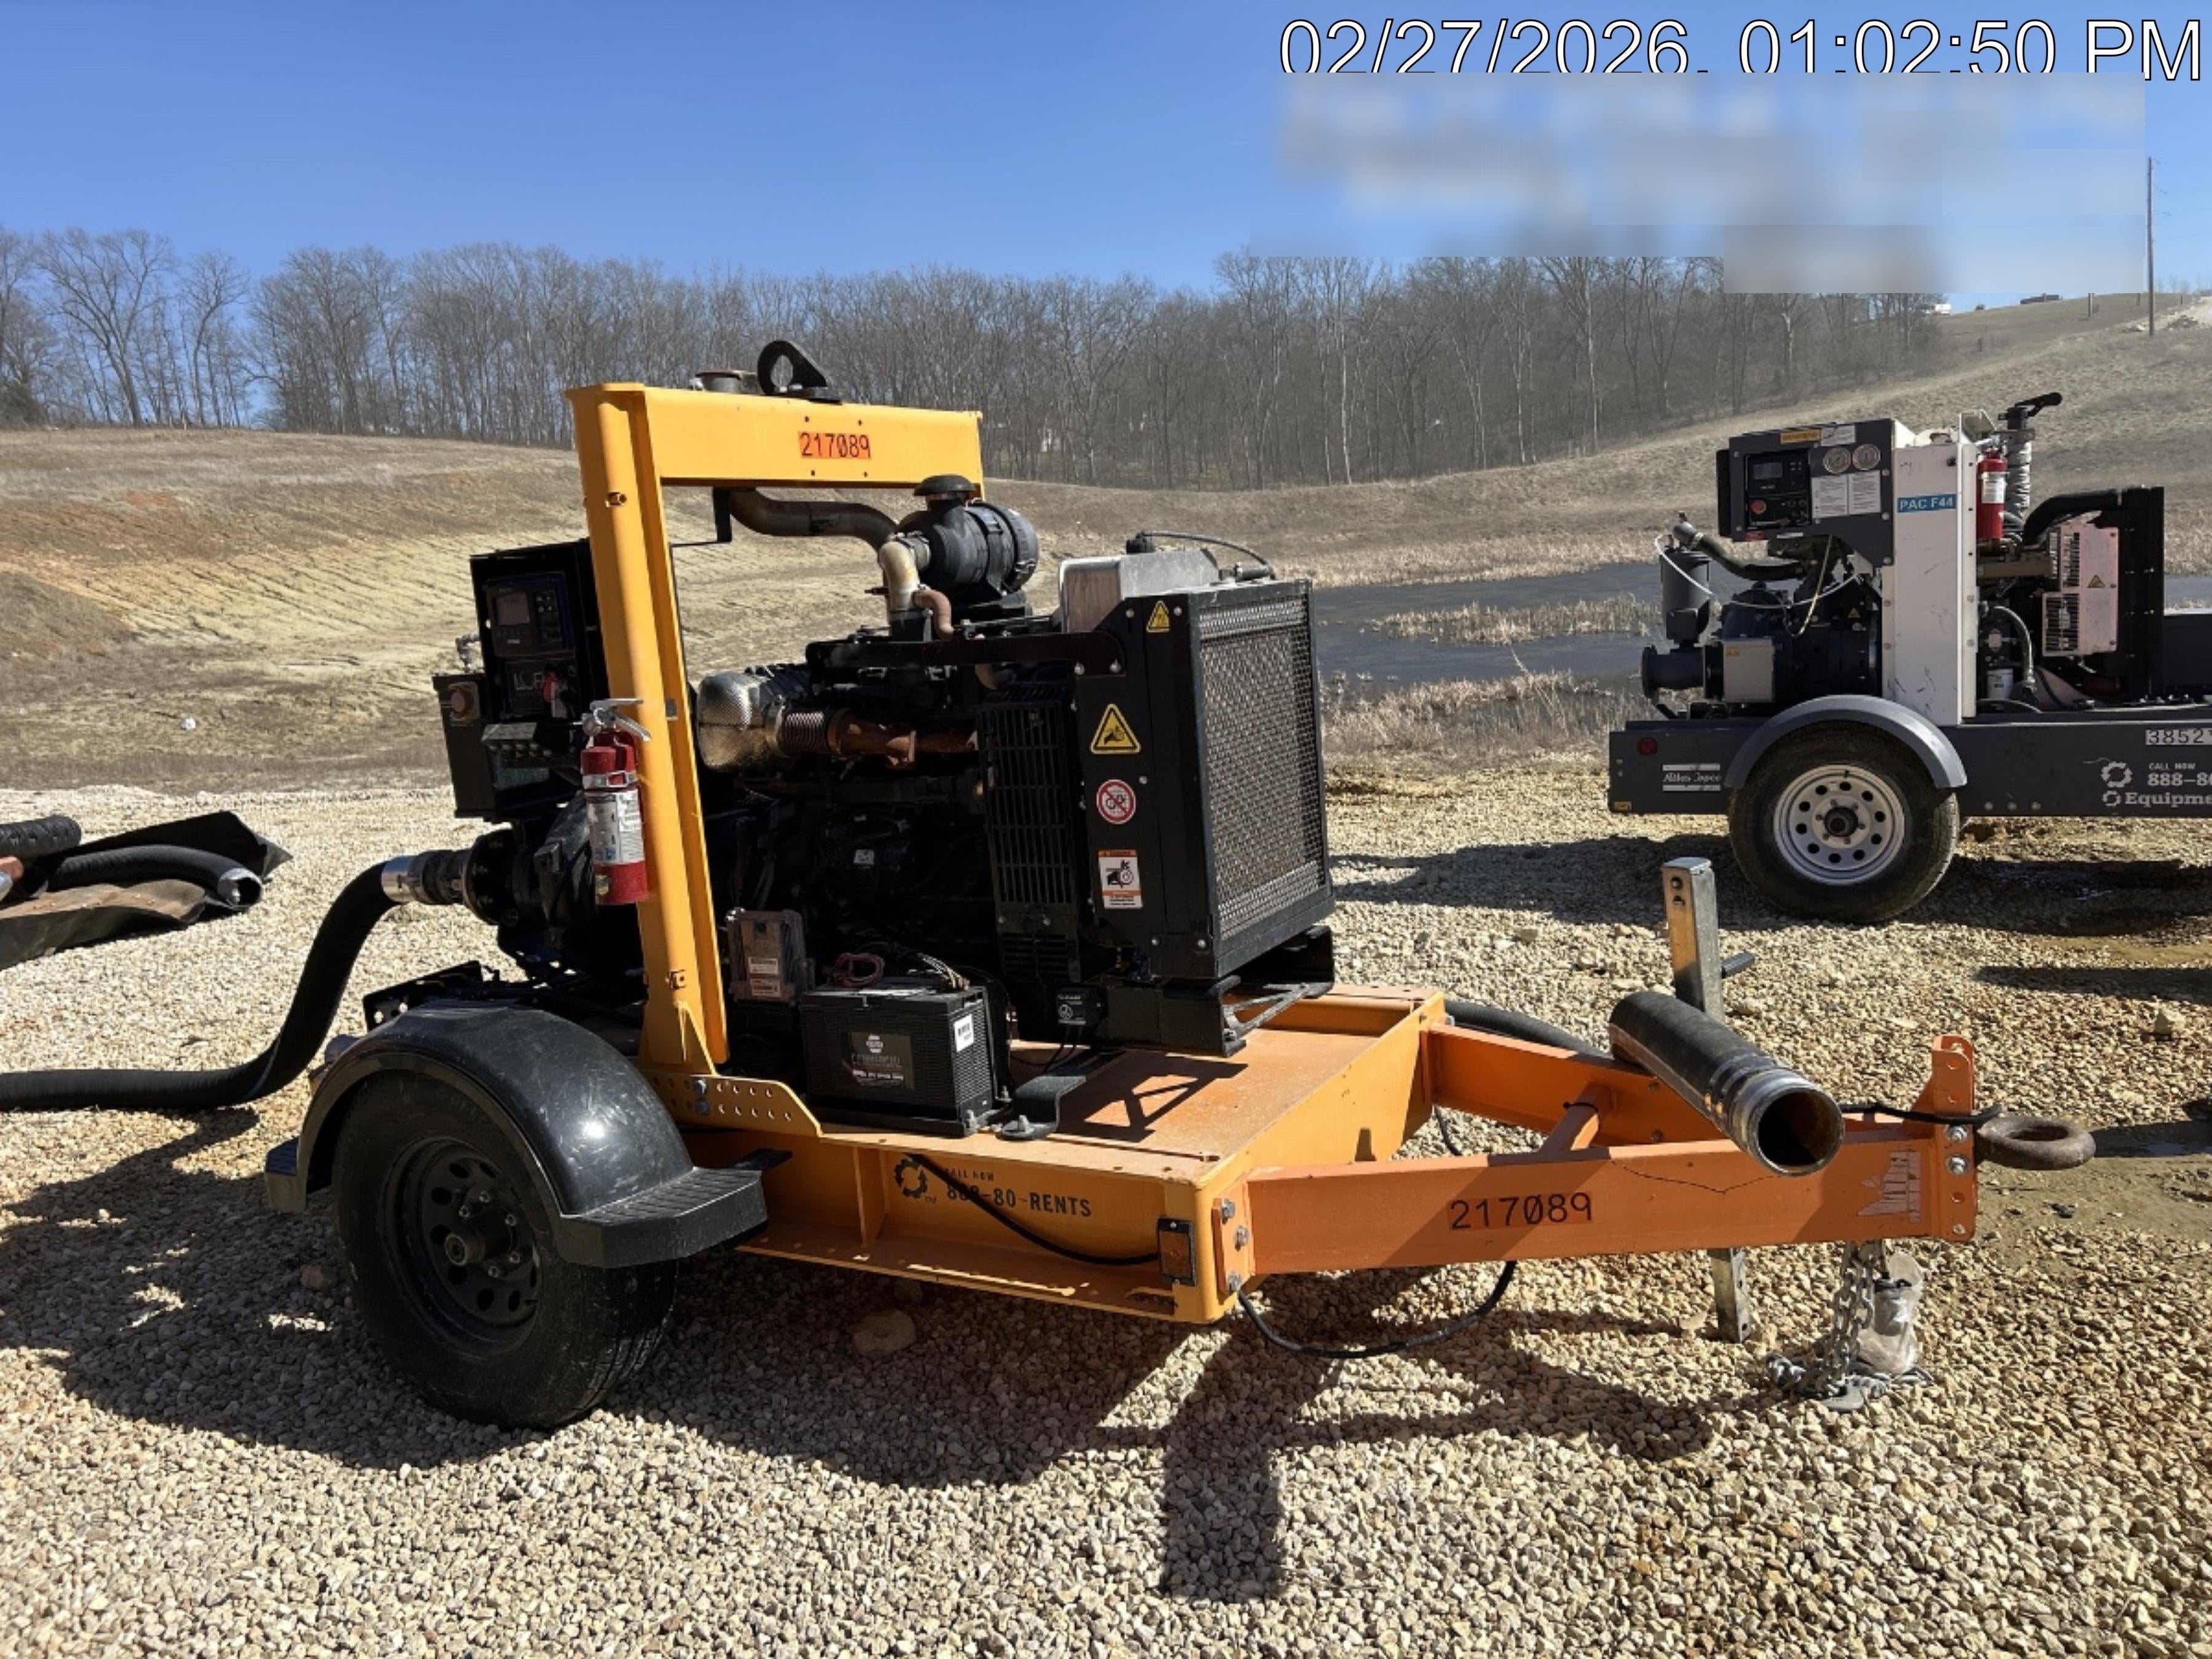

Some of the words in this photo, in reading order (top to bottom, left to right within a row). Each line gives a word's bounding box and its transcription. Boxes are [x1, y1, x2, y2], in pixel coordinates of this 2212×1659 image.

[800, 432, 871, 458] 217089
[1900, 498, 1928, 511] PAC
[1931, 496, 1953, 508] F44
[2147, 772, 2212, 786] 888-8
[973, 1170, 995, 1181] NOW
[1449, 1191, 1592, 1230] 217089
